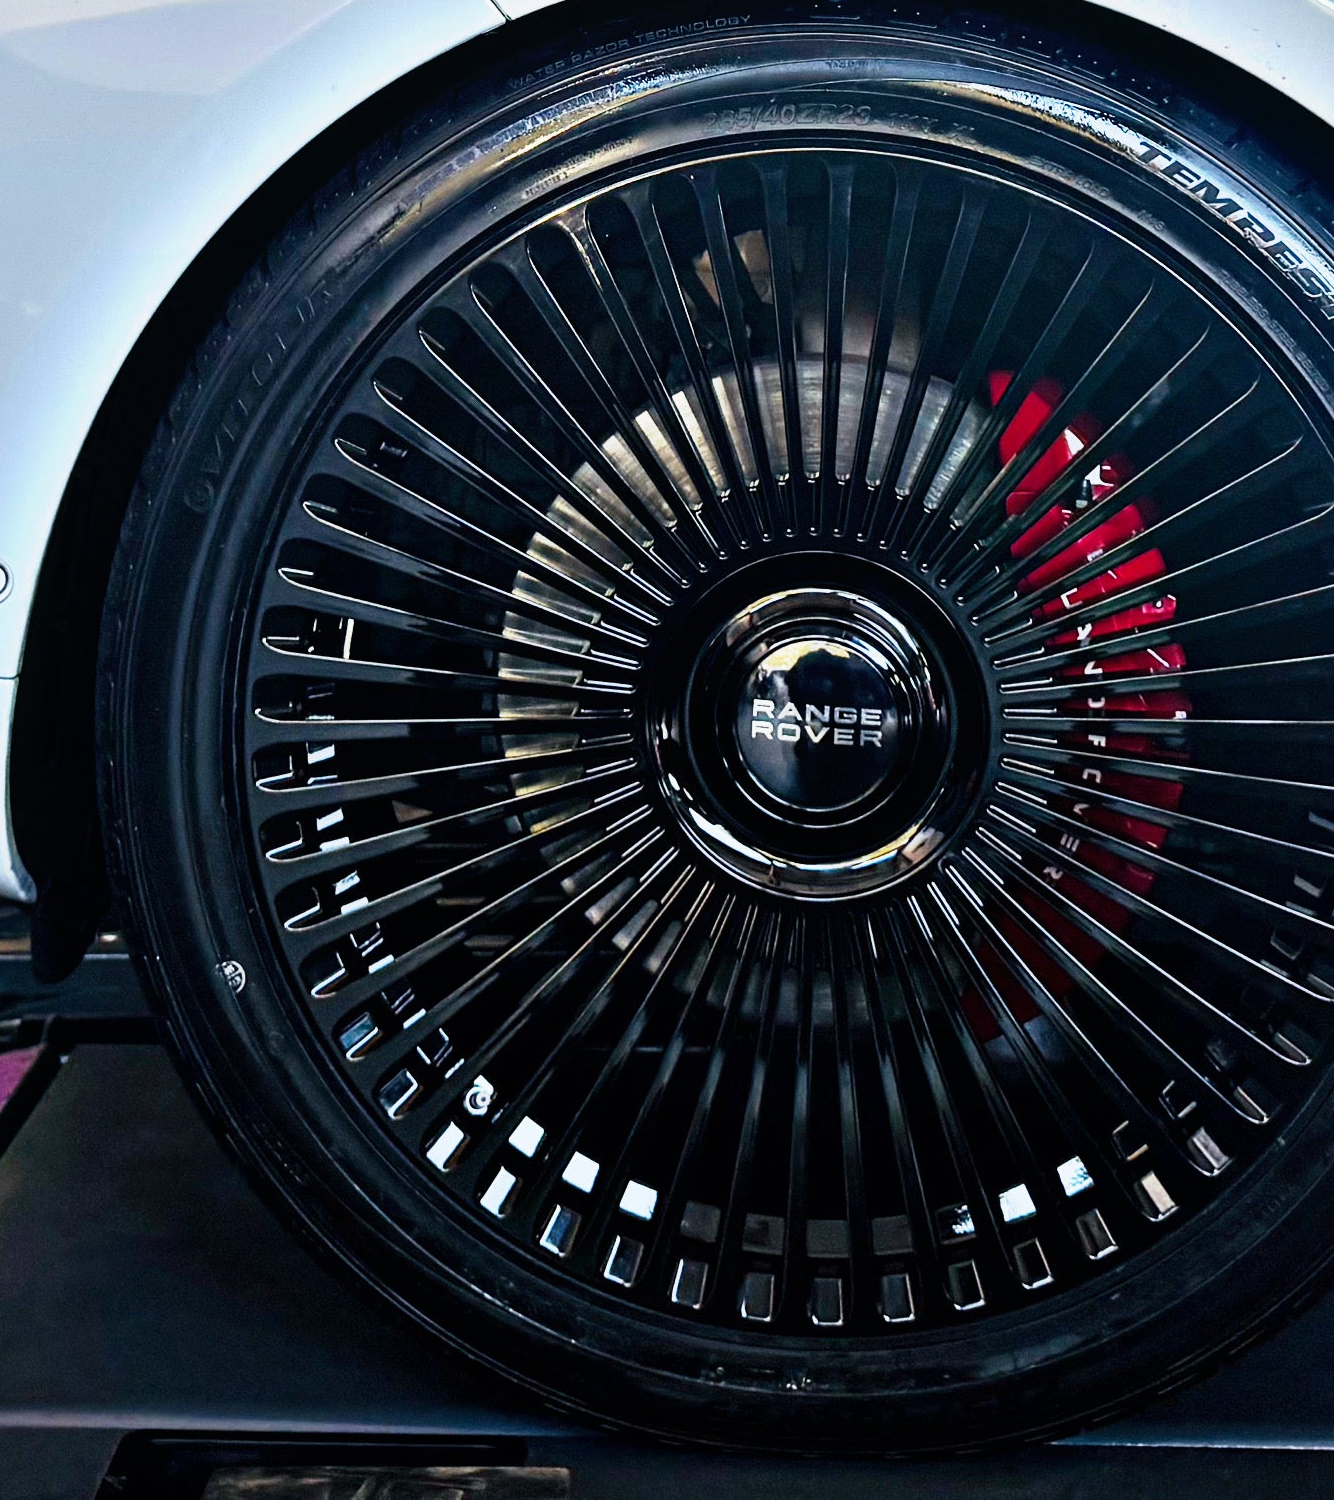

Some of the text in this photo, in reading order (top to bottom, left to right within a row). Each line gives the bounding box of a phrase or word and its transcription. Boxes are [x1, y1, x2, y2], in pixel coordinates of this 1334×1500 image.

[508, 14, 750, 91] WATER RAZOR TECHNOLOGY
[753, 699, 883, 726] RANGE
[751, 720, 883, 748] ROVER
